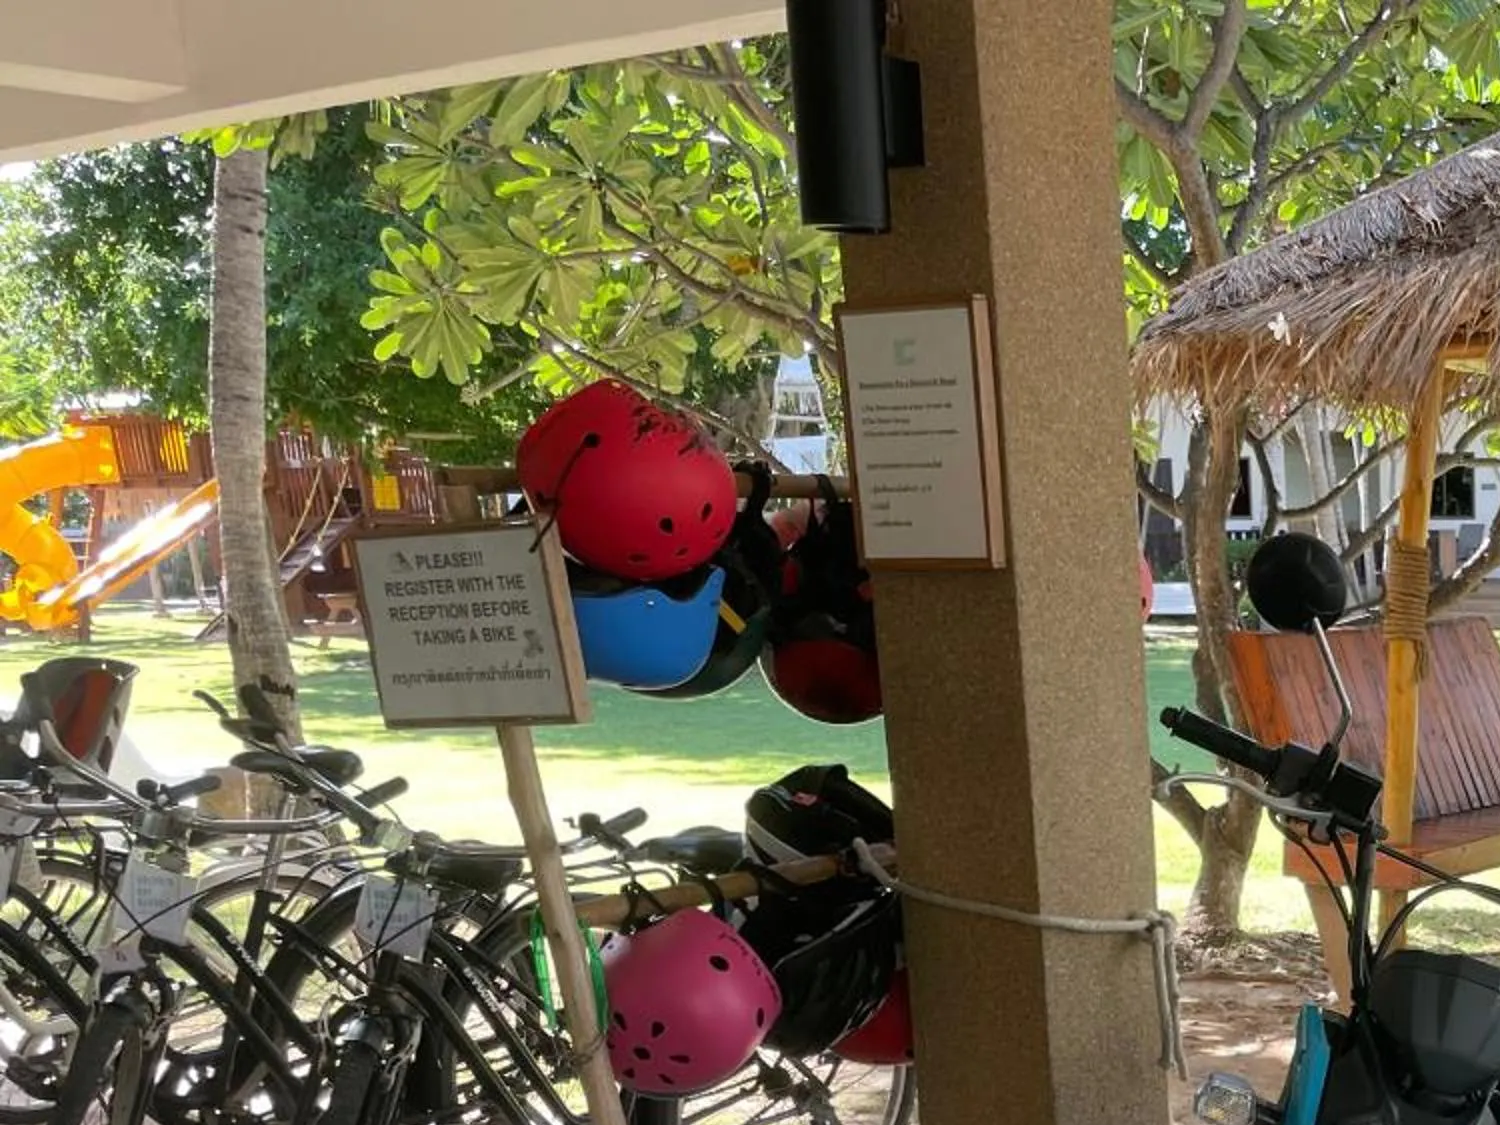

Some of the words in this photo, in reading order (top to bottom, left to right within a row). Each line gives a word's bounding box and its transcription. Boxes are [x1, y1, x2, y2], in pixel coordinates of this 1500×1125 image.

[415, 551, 483, 570] PLEASE!!!
[384, 578, 455, 598] REGISTER
[457, 576, 494, 594] WITH
[496, 574, 526, 591] THE
[389, 603, 469, 622] RECEPTION
[472, 600, 531, 618] BEFORE
[414, 628, 466, 646] TAKING
[469, 627, 482, 643] A
[483, 626, 517, 642] BIKE
